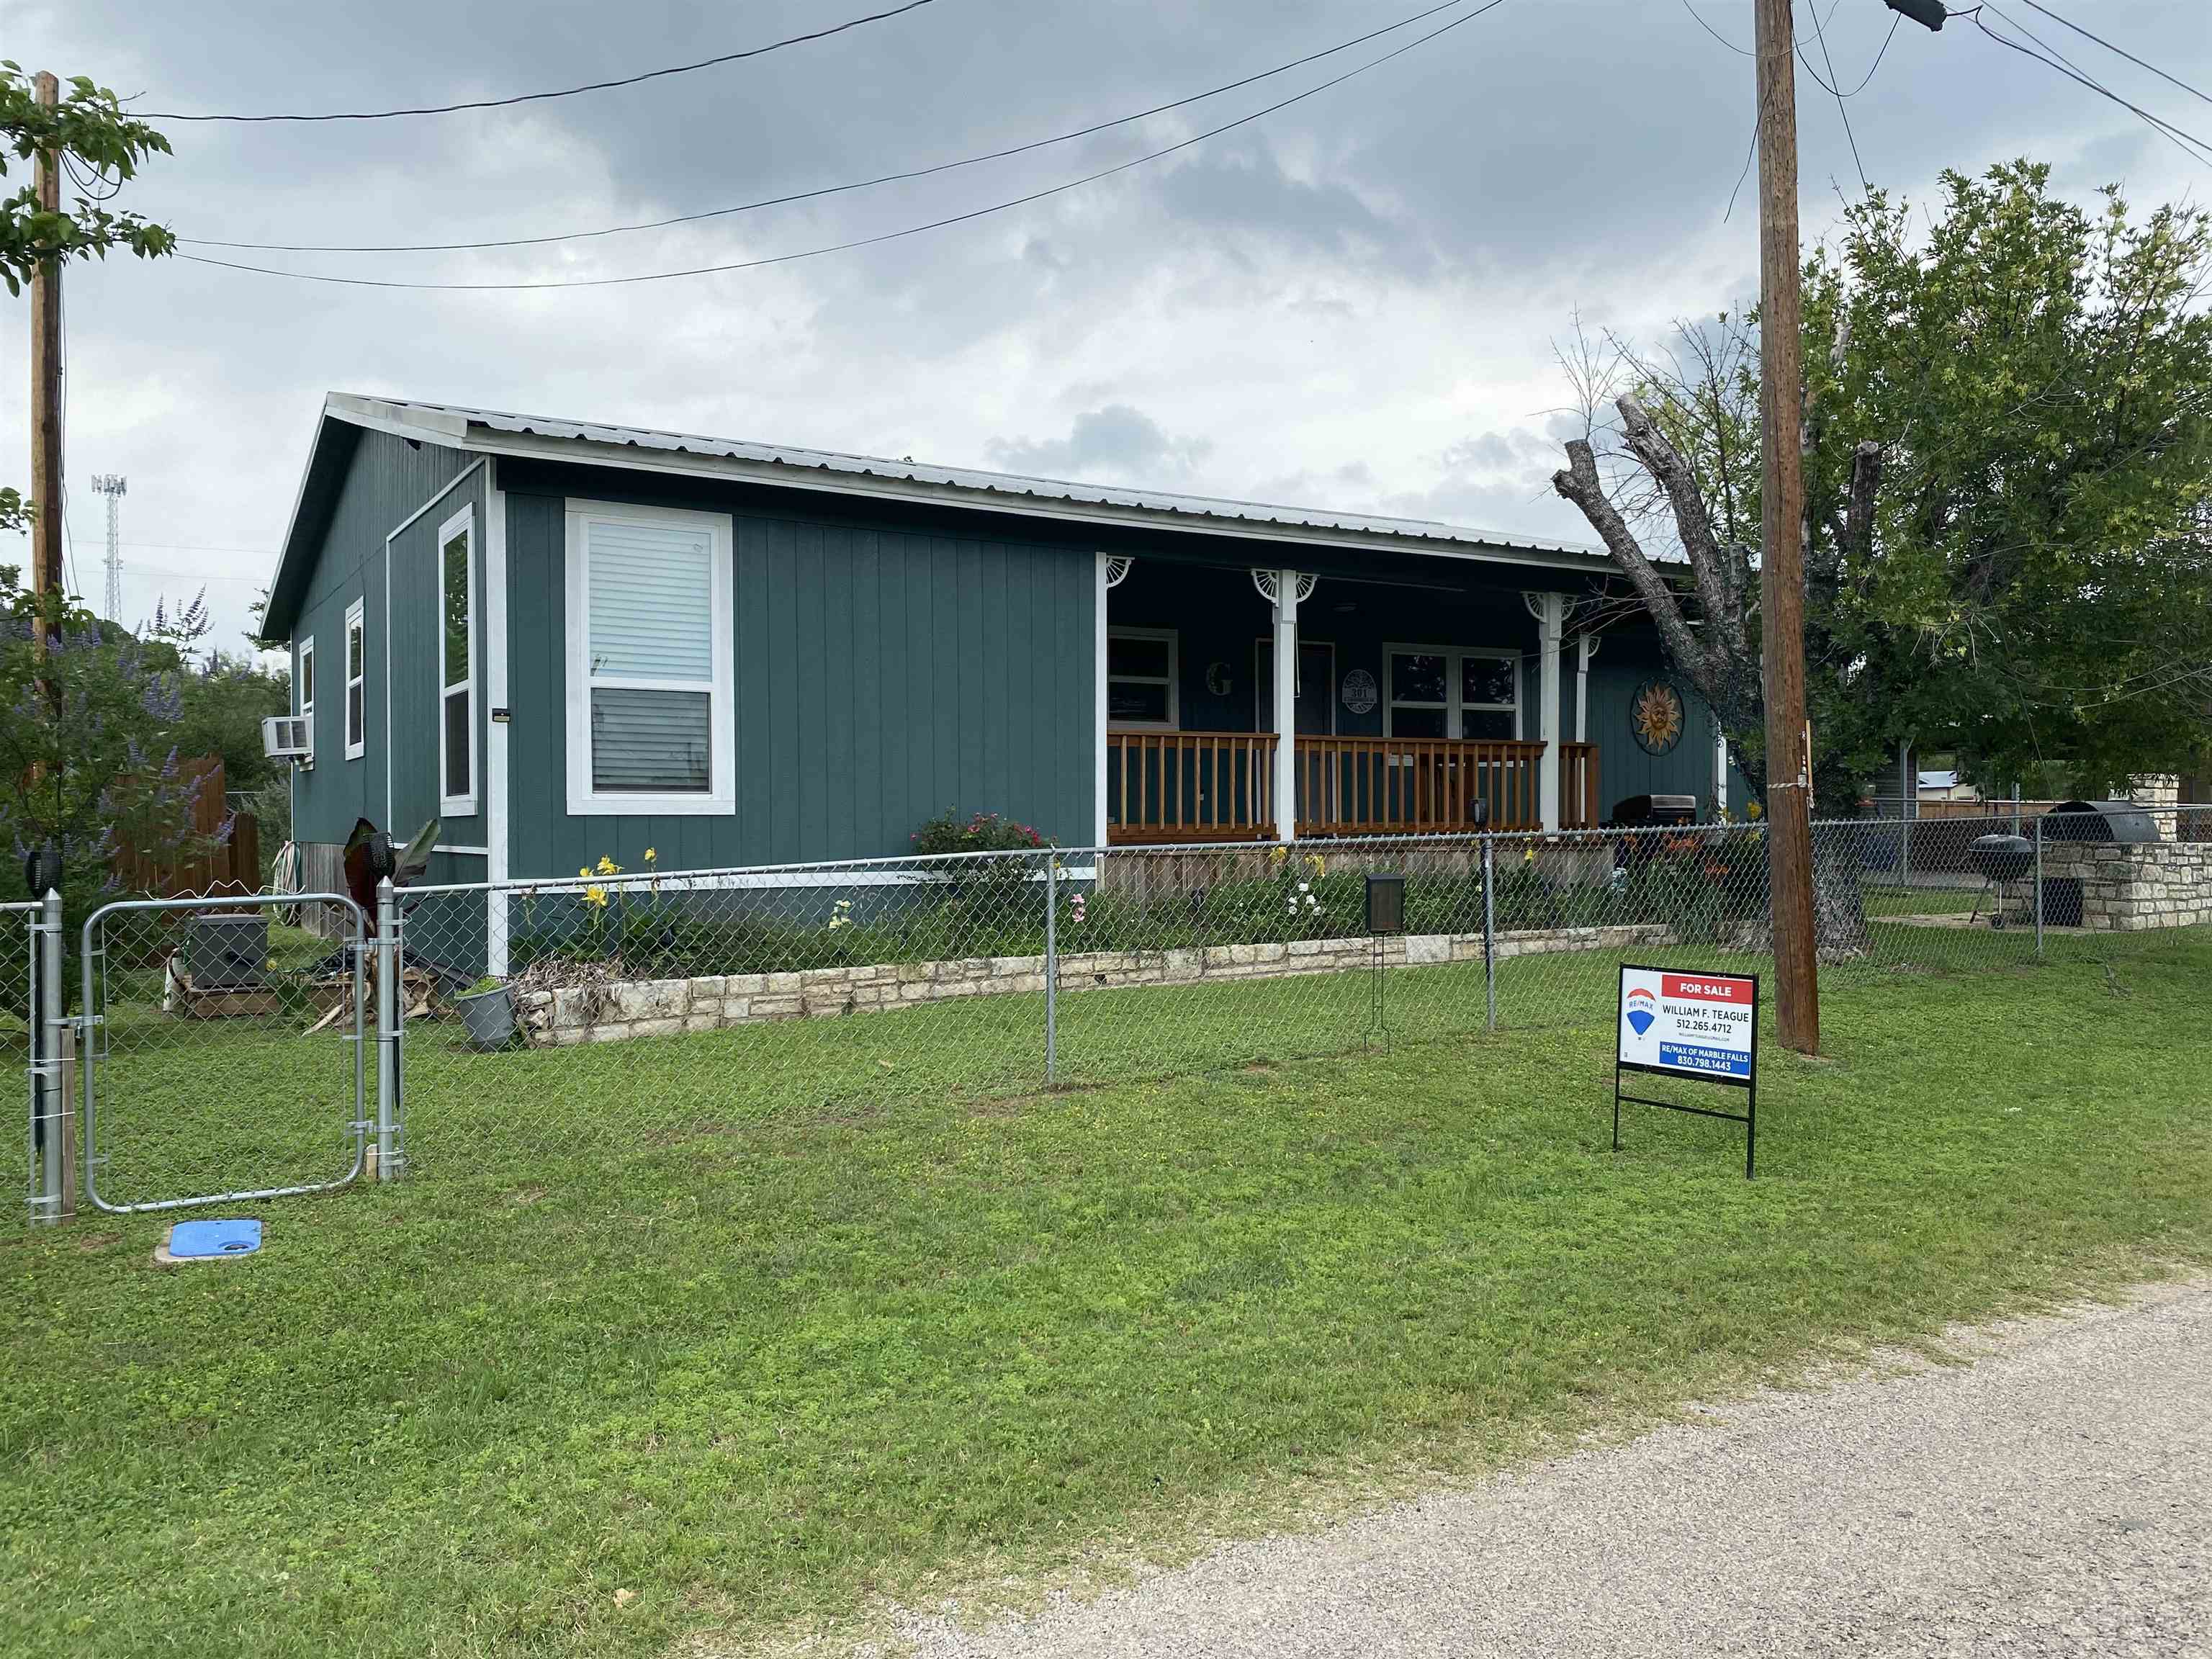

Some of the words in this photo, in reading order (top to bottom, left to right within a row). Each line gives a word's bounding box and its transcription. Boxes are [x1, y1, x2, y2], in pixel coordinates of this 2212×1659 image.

[1205, 662, 1233, 696] G
[1680, 983, 1701, 994] FOR
[1704, 984, 1732, 997] SALE
[1629, 1000, 1653, 1010] RE/MAX
[1663, 1004, 1699, 1017] WILLIAM
[1702, 1009, 1710, 1018] F.
[1712, 1010, 1749, 1022] TEAGUE
[1676, 1019, 1732, 1034] 512.265.4712
[1662, 1044, 1687, 1055] RE/MAX
[1699, 1049, 1726, 1060] MARBLE
[1727, 1053, 1748, 1063] FALLS
[1677, 1056, 1731, 1071] 830.798.1443
